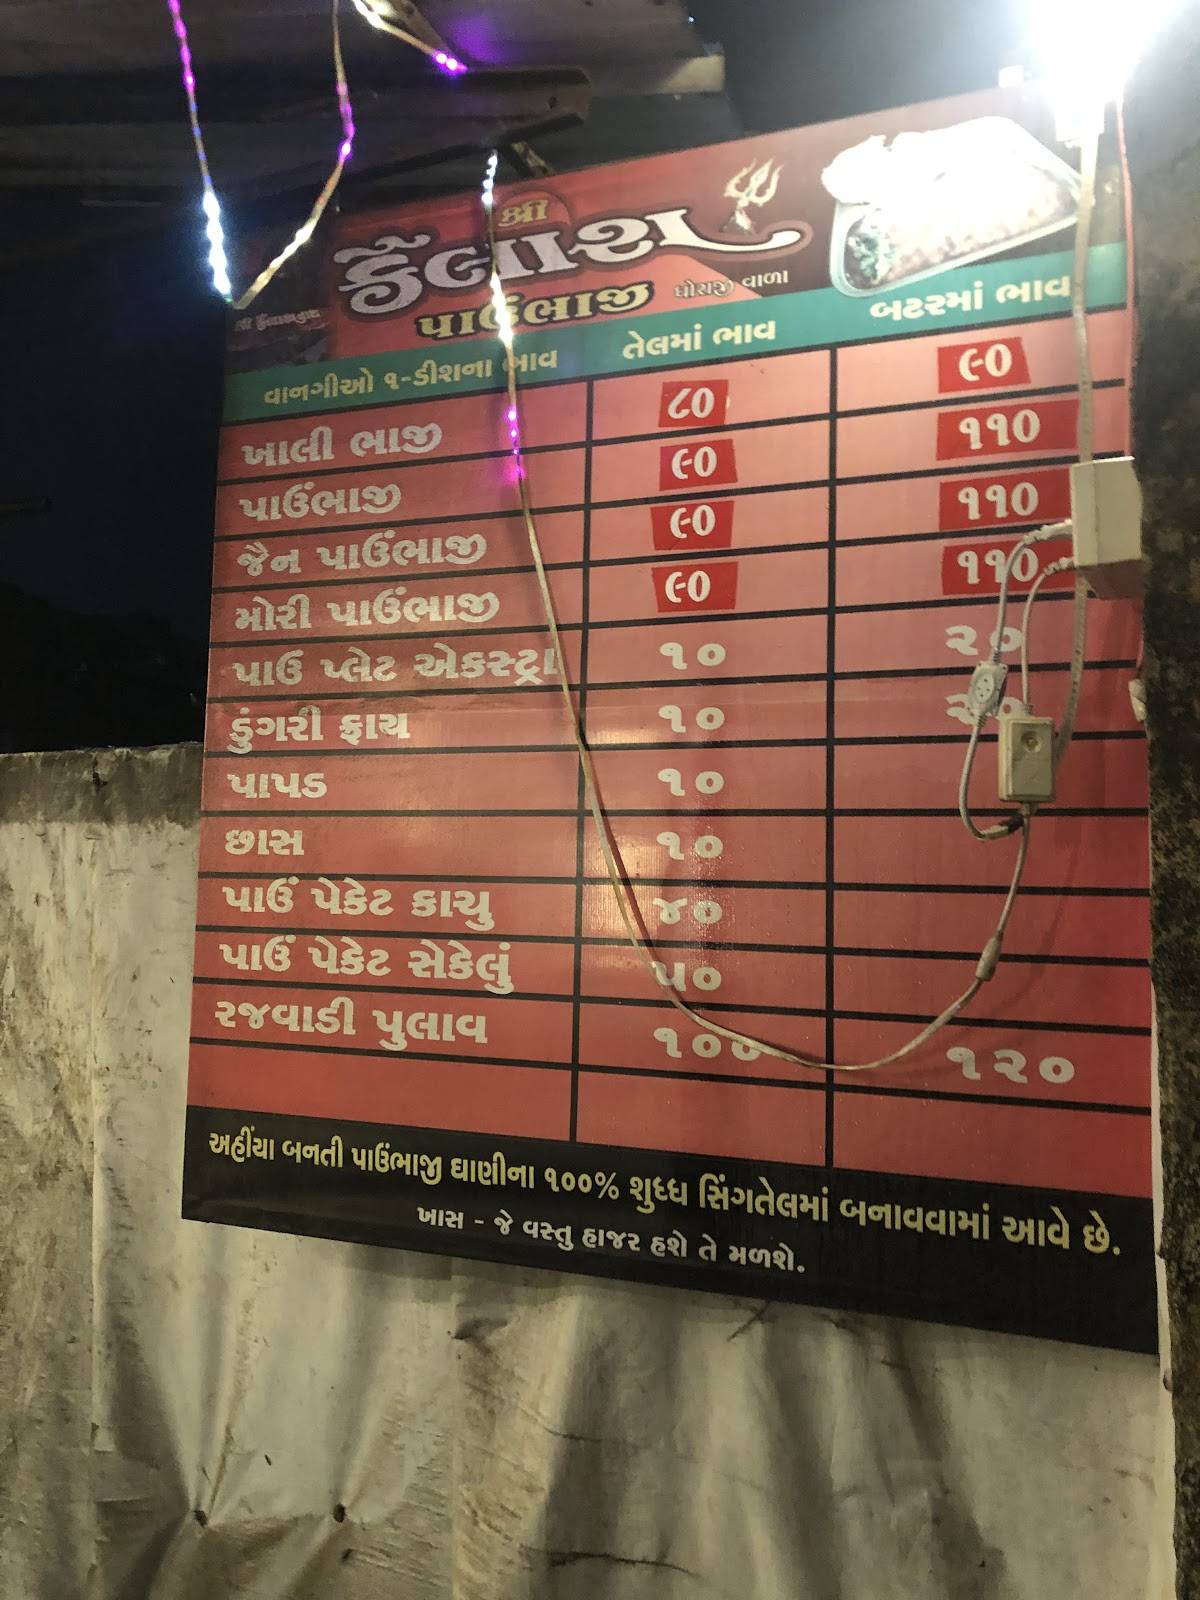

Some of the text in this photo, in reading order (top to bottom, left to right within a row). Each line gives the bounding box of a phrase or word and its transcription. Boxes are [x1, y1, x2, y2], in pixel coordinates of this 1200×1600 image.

[498, 200, 548, 226] શ્રી
[742, 270, 788, 287] વાળા
[870, 275, 1071, 321] બટરમાં ભાવ
[622, 319, 776, 360] તેલમાં ભાવ
[264, 368, 373, 404] વાનગીઓ
[502, 350, 558, 372] ભાવ
[959, 343, 1013, 381] ૯૦
[667, 387, 715, 420] ૮૦
[241, 422, 442, 466] ખાલી ભાજી
[959, 409, 1040, 450] ૧૧૦
[671, 446, 717, 479] ૯૦
[239, 481, 401, 522] પાઉંભાજી
[958, 482, 1039, 520] ૧૧૦
[670, 504, 716, 539] ૯૦
[236, 530, 488, 577] જૈન પાઉંભાજી
[958, 548, 1039, 584] ૧૧૦
[665, 570, 711, 603] ૯૦
[235, 586, 500, 631] મોરી પાઉંભાજી
[659, 642, 726, 670] ૧૦
[945, 625, 1024, 655] ૨૦
[232, 649, 304, 687] પાઉ
[320, 646, 398, 682] પ્લેટ
[227, 705, 323, 754] ડુંગરી
[658, 704, 725, 733] ૧૦
[227, 771, 328, 798] પાપડ
[657, 768, 725, 796] ૧૦
[225, 829, 305, 856] છાસ
[656, 831, 724, 860] ૧૦
[222, 876, 495, 932] પાઉં પેકેટ કાચુ
[653, 897, 723, 925] ૪૦
[219, 935, 514, 995] પાઉં પેકેટ સેકેલું
[652, 961, 722, 992] ૫૦
[215, 996, 488, 1051] રજવાડી પુલાવ
[653, 1027, 761, 1061] ૧૦૦
[946, 1046, 1075, 1084] ૧૨૦
[209, 1126, 274, 1163] અહીંયા
[282, 1136, 344, 1168] બનતી
[352, 1142, 442, 1186] પાઉંભાજી
[450, 1151, 534, 1189] ઘાણીના
[544, 1167, 620, 1200] ૧૦૦%
[699, 1173, 829, 1222] સિંગતેલમાં
[839, 1198, 990, 1241] બનાવવામાં
[1001, 1206, 1070, 1249] આવે
[1082, 1209, 1121, 1256] છે.
[417, 1206, 464, 1230] ખાસ
[494, 1209, 515, 1236] જે
[522, 1220, 574, 1251] વસ્તુ
[581, 1227, 641, 1252] હાજર
[650, 1229, 688, 1258] હશે
[698, 1233, 718, 1262] તે
[728, 1242, 806, 1273] મળશે.
